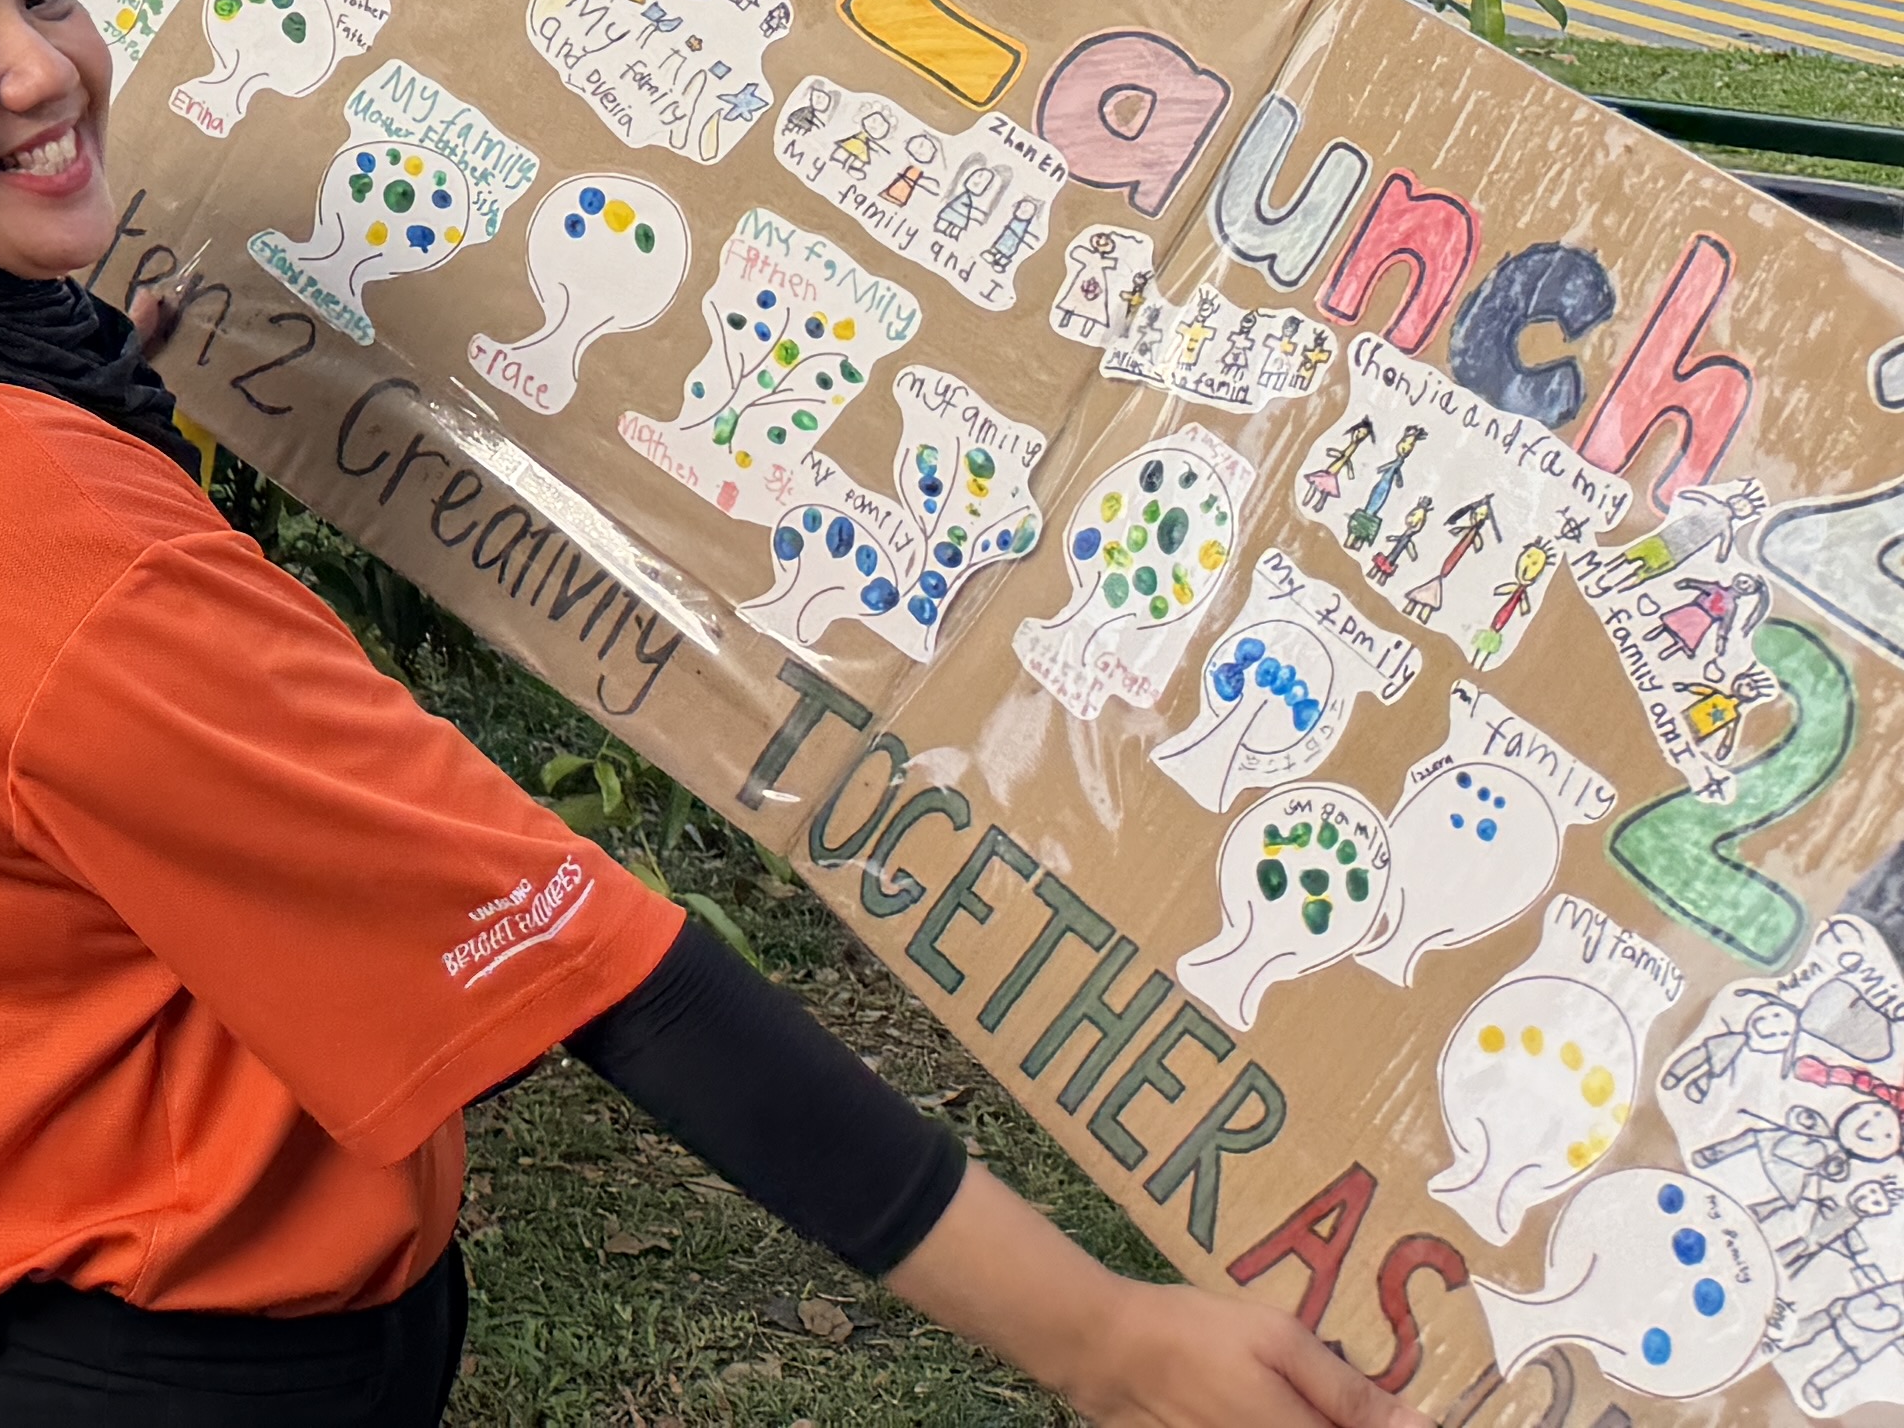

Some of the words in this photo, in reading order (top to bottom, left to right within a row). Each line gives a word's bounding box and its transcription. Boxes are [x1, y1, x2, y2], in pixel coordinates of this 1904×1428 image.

[838, 184, 920, 251] family
[930, 240, 978, 283] and
[1462, 403, 1523, 455] and
[735, 659, 1287, 1254] TOGETHER
